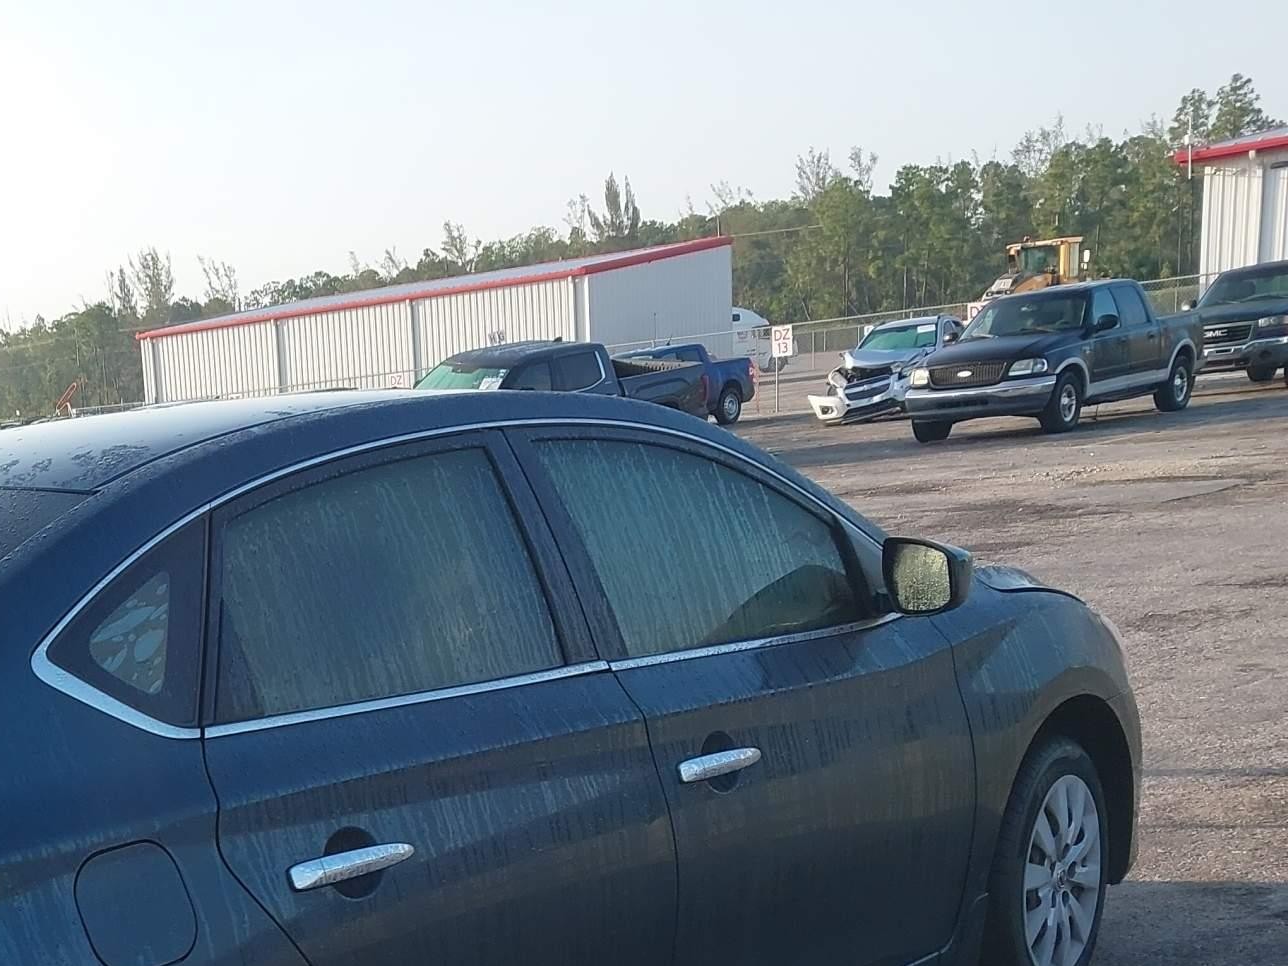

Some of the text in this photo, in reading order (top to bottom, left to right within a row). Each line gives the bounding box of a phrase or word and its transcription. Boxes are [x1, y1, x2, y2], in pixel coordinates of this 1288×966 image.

[774, 328, 791, 342] DZ
[777, 342, 788, 355] 13
[390, 375, 402, 386] DZ
